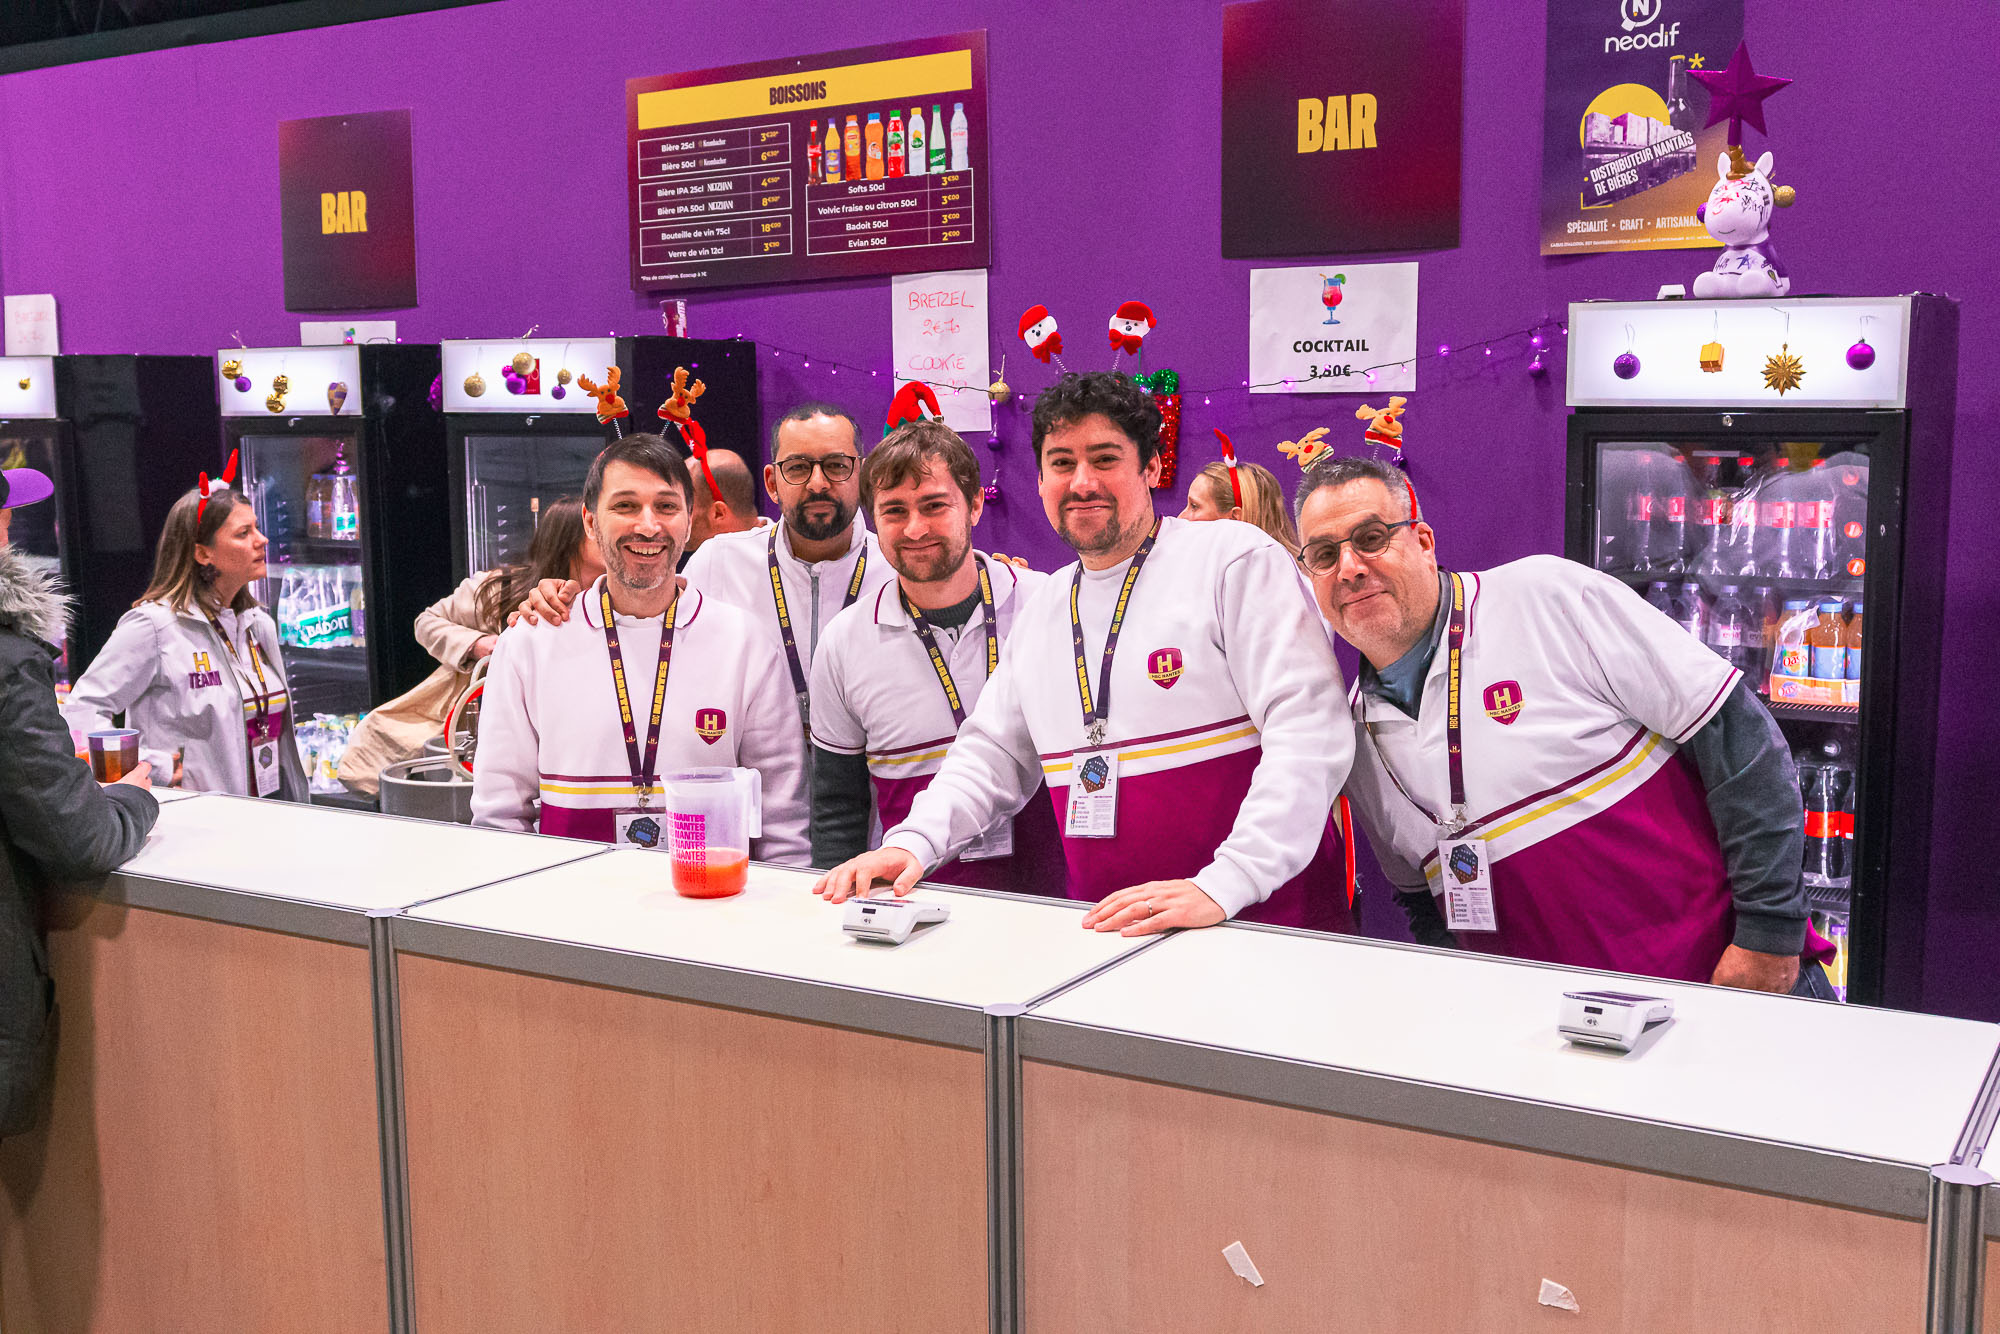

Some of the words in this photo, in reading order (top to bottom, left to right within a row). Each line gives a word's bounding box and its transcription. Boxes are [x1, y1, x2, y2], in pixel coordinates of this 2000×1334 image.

[1605, 22, 1681, 53] neodif
[769, 80, 827, 105] BOISSONS
[1298, 92, 1378, 154] BAR
[661, 143, 680, 152] Bière
[681, 141, 695, 149] 25cl
[1590, 147, 1654, 182] DISTRIBUTEUR
[1652, 131, 1694, 158] NANTAIS
[661, 162, 680, 171] Bière
[681, 160, 696, 168] 50cl
[657, 188, 676, 197] Bière
[676, 187, 689, 195] IPA
[690, 186, 704, 194] 25cl
[848, 184, 867, 194] Softs
[869, 182, 885, 192] 50cl
[1594, 181, 1608, 196] DE
[321, 191, 367, 234] BAR
[657, 207, 676, 216] Bière
[676, 206, 689, 214] IPA
[690, 204, 705, 213] 50cl
[818, 205, 841, 215] Volvic
[842, 202, 863, 213] fraise
[876, 200, 899, 210] citron
[900, 198, 917, 208] 50cl
[846, 221, 871, 231] Badoit
[872, 219, 889, 229] 50cl
[1567, 218, 1608, 233] SPÉCIALITÉ
[1620, 218, 1644, 231] CRAFT
[661, 231, 692, 241] Bouteille
[692, 229, 702, 238] de
[703, 228, 715, 237] vin
[715, 227, 730, 236] 75cl
[848, 239, 870, 248] Evian
[870, 237, 887, 246] 50cl
[668, 249, 687, 258] Verre
[688, 248, 697, 257] de
[698, 248, 710, 256] vin
[711, 246, 724, 255] 12cl
[908, 290, 974, 310] BRETZEL
[1293, 339, 1369, 353] COCKTAIL
[908, 353, 966, 371] COOKIE
[770, 566, 787, 618] NANTES
[1114, 566, 1139, 622] NANTES
[307, 616, 349, 640] BADOIT
[193, 652, 211, 672] H
[988, 637, 997, 677] NTES
[1157, 654, 1173, 673] H
[188, 671, 222, 689] TEAM
[1162, 670, 1181, 678] NANTES
[1449, 648, 1460, 716] NANTES
[652, 661, 668, 715] NANTES
[933, 657, 961, 711] NANTES
[614, 668, 632, 724] NANTES
[1493, 688, 1512, 710] H
[1501, 703, 1521, 714] NANTES
[704, 714, 718, 731] H
[1449, 716, 1459, 729] HBC
[674, 812, 706, 822] NANTES
[674, 821, 706, 832] NANTES
[675, 830, 706, 841] NANTES
[675, 839, 706, 851] NANTES
[676, 849, 706, 861] NANTES
